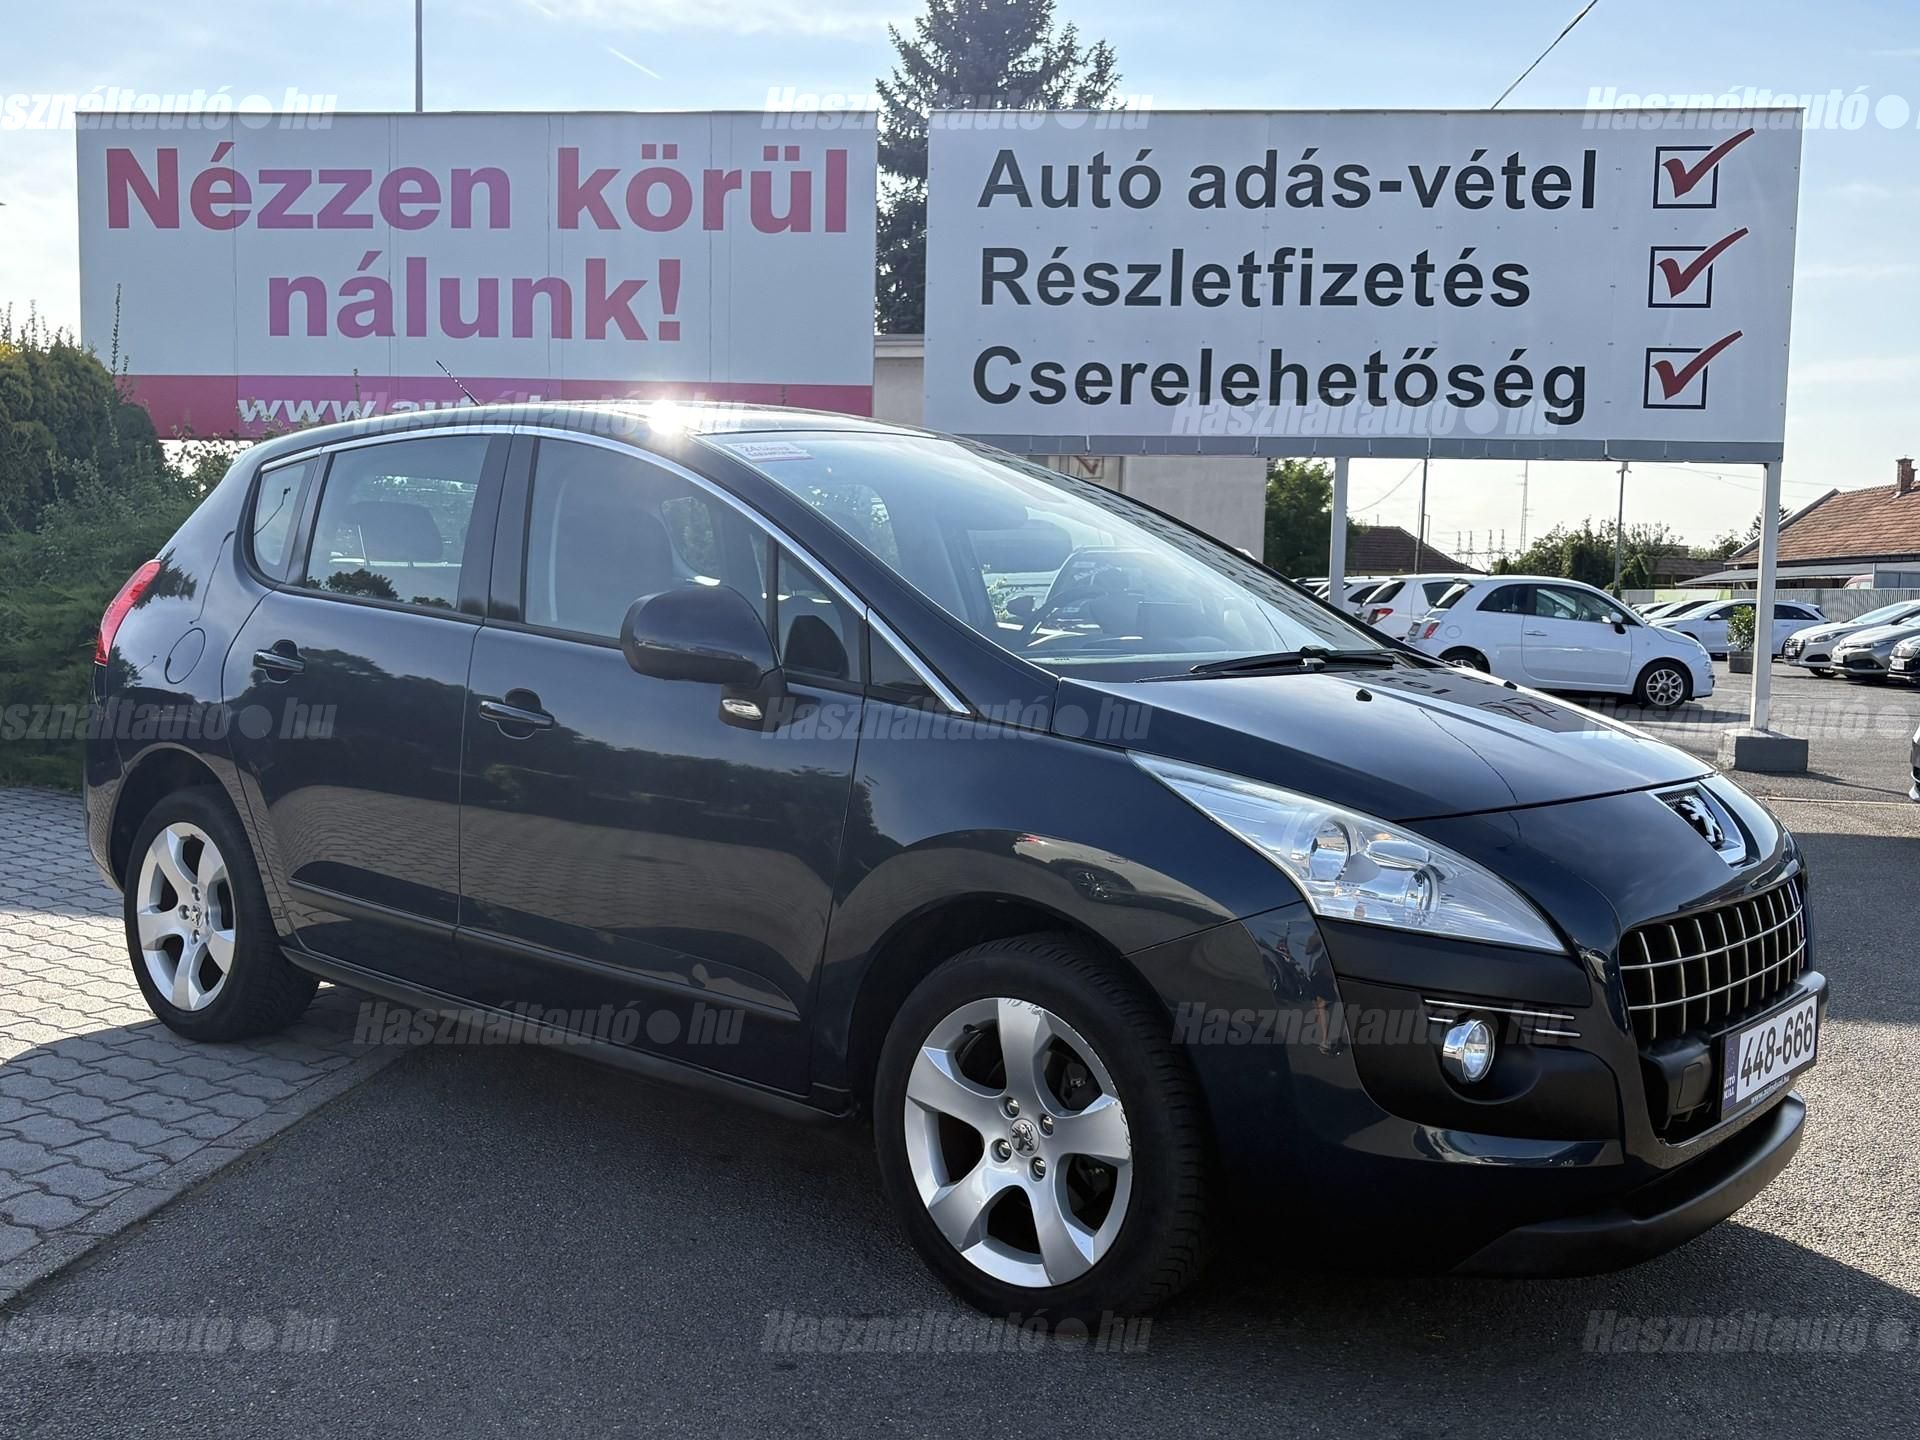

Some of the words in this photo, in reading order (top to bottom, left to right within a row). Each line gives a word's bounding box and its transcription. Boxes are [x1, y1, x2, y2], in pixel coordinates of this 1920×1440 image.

[106, 141, 511, 231] Nézzen
[557, 143, 848, 234] körül
[977, 148, 1162, 210] Autó
[1188, 147, 1597, 210] adás-vétel
[268, 250, 681, 341] nálunk!
[981, 246, 1531, 308] Részletfizetés
[973, 345, 1586, 425] Cserelehetőség
[1741, 1005, 1814, 1087] 448-666
